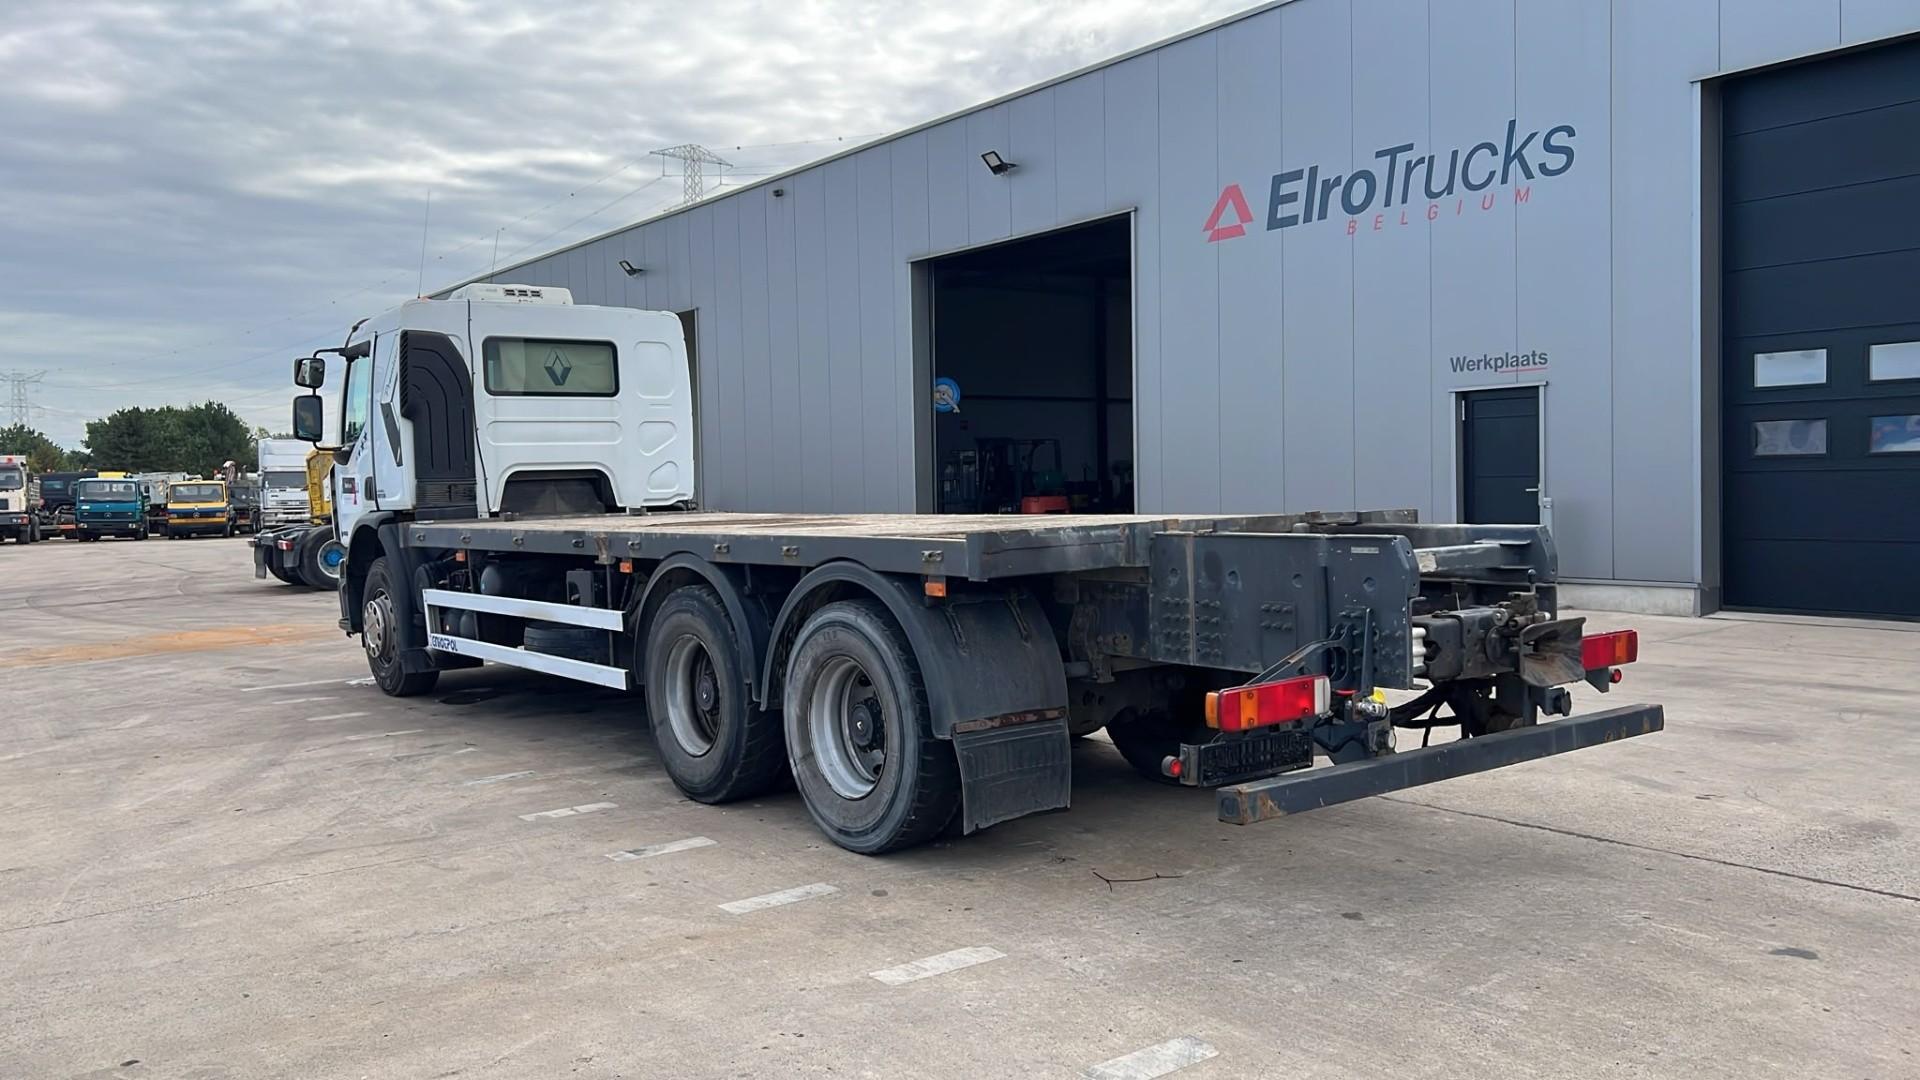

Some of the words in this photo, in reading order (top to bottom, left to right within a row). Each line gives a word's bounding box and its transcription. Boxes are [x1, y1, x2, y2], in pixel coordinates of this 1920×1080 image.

[1266, 119, 1576, 231] ElroTrucks
[1346, 186, 1531, 236] BELGIUM
[1450, 350, 1548, 373] Werkplaats
